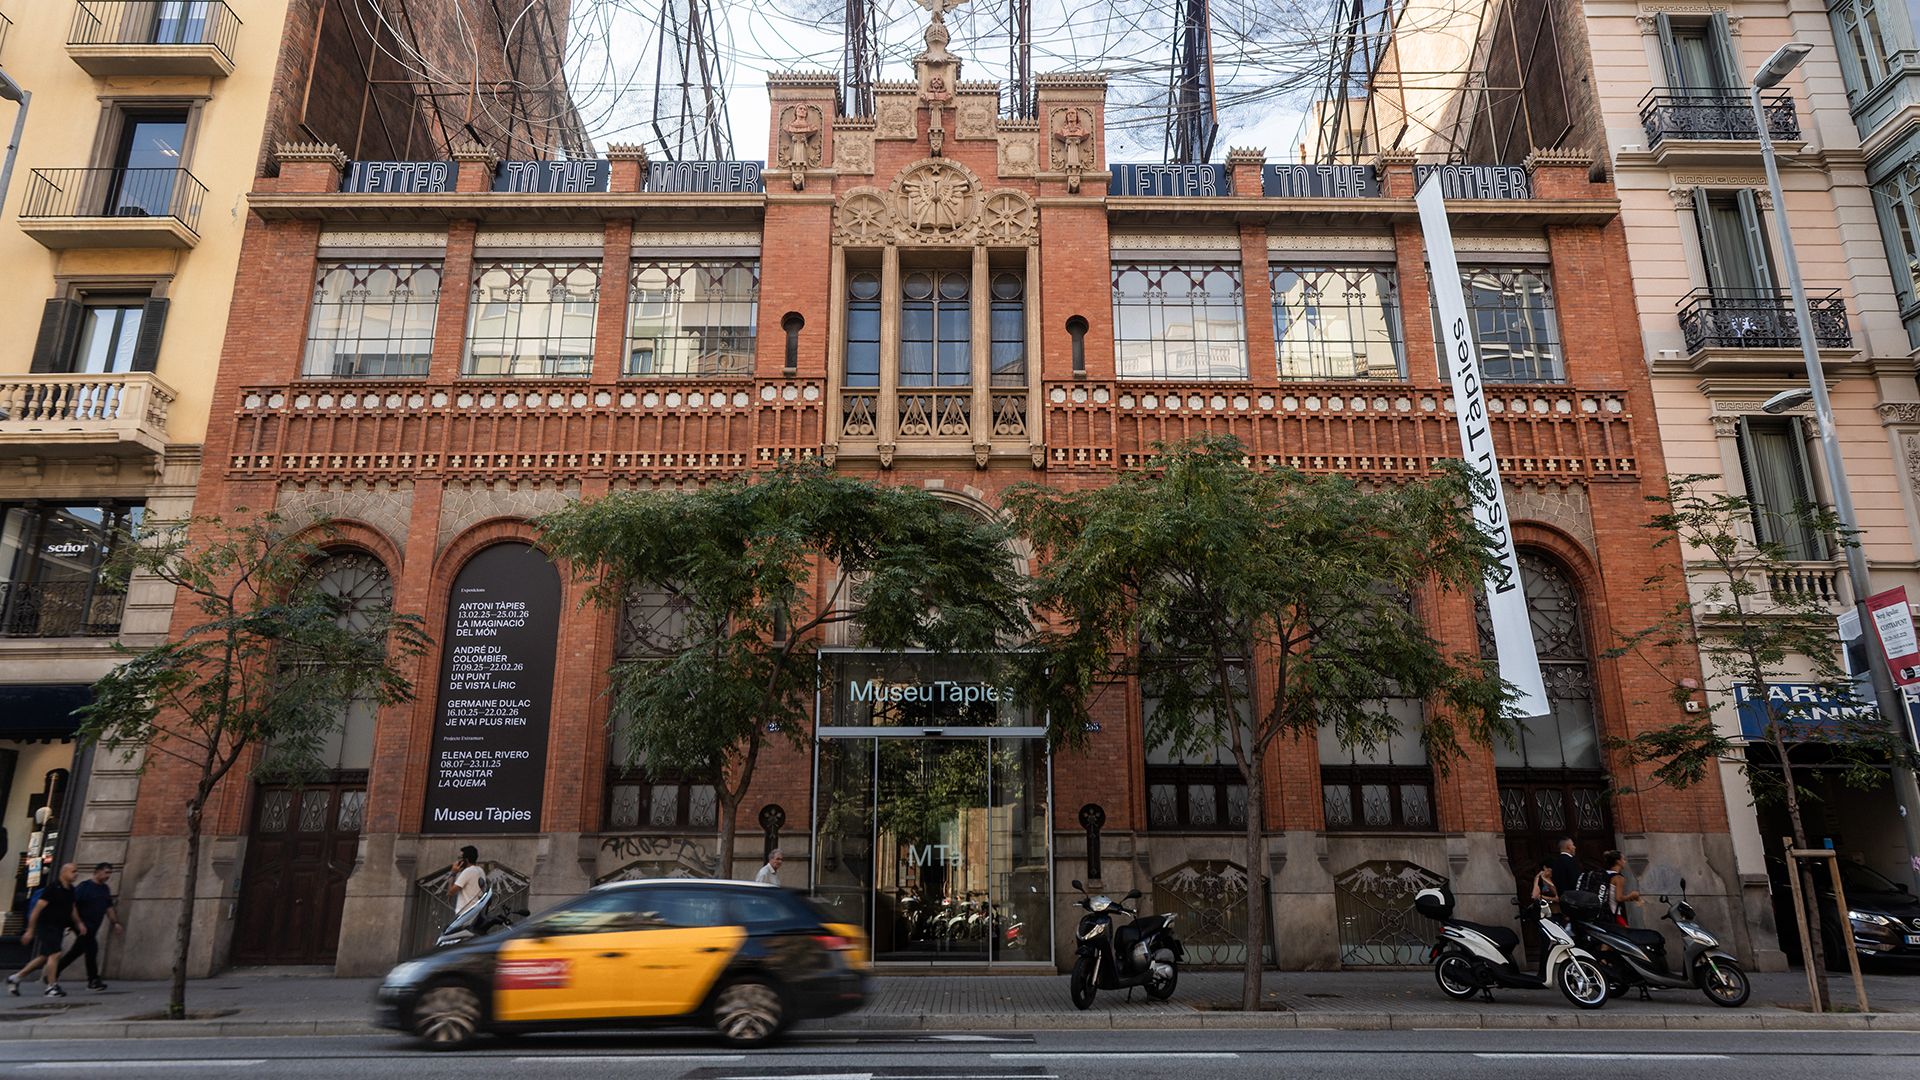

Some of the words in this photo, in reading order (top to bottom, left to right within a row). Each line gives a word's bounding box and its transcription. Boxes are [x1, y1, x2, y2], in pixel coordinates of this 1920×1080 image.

[549, 161, 597, 193] THE
[650, 161, 760, 193] MOTHER
[1316, 164, 1366, 198] THE
[1453, 316, 1485, 452] Tàpies
[47, 542, 89, 552] señor
[459, 602, 494, 610] ANTONI
[495, 601, 526, 610] TÀPIES
[457, 620, 469, 628] LA
[470, 618, 525, 628] IMAGINACIÓ
[475, 627, 497, 636] MÓN
[453, 645, 486, 654] ANDRÉ
[452, 655, 508, 663] COLOMBIER
[450, 673, 464, 681] UN
[466, 672, 492, 680] PUNT
[449, 682, 463, 690] DE
[464, 681, 491, 689] VISTA
[492, 680, 516, 689] LÍRIC
[849, 680, 932, 702] Museu
[447, 700, 497, 708] GERMAINE
[445, 718, 457, 726] JE
[479, 718, 503, 726] PLUS
[441, 751, 473, 759] ELENA
[475, 751, 493, 759] DEL
[494, 751, 530, 759] RIVERO
[440, 769, 493, 777] TRANSITAR
[452, 779, 487, 788] QUEMA
[434, 808, 483, 821] Museu
[485, 807, 532, 823] Tàpies
[908, 844, 963, 867] MTà
